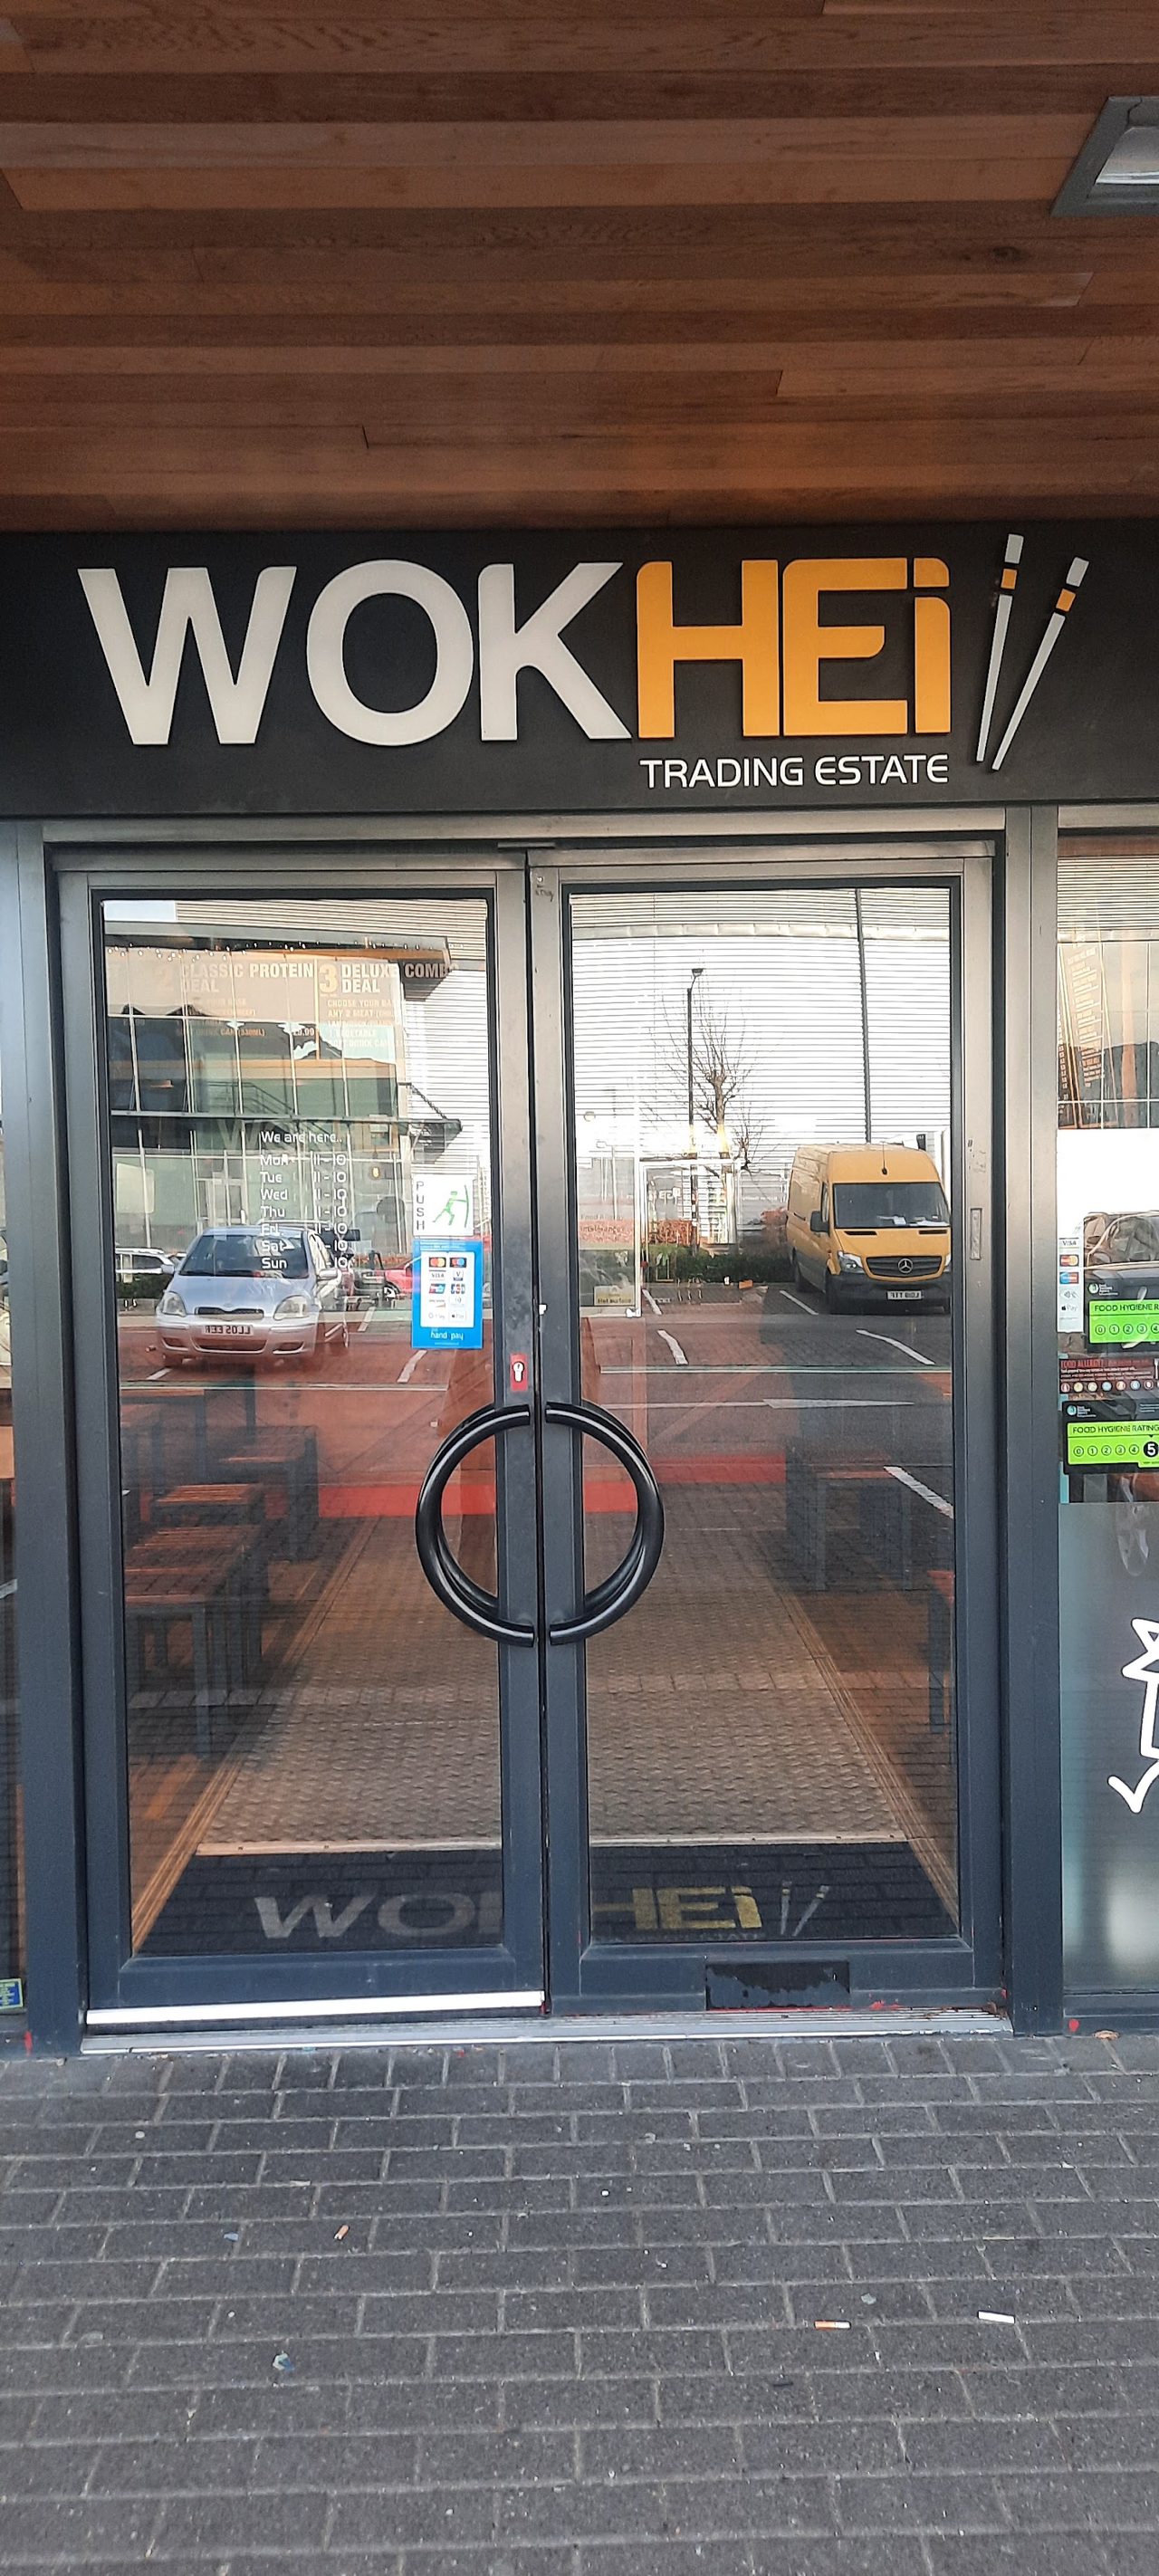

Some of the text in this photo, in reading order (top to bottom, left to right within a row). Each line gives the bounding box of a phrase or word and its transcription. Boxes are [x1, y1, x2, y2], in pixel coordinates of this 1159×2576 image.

[639, 754, 949, 789] TRADING ESTATE
[182, 962, 313, 979] CLASSIC PROTEIN
[341, 962, 399, 979] DELUXE
[319, 963, 338, 994] 3
[341, 978, 381, 993] DEAL
[261, 1130, 281, 1143] We
[283, 1133, 305, 1143] are
[260, 1154, 289, 1165] Mon
[259, 1171, 283, 1183] Tue
[260, 1188, 288, 1201] Wed
[260, 1205, 285, 1218] Thu
[261, 1240, 284, 1251] Sat
[261, 1257, 287, 1269] Sun
[1094, 1304, 1118, 1312] FOOD
[1119, 1303, 1154, 1311] HYGIENE
[430, 1329, 447, 1338] hand
[1146, 1442, 1156, 1456] 5
